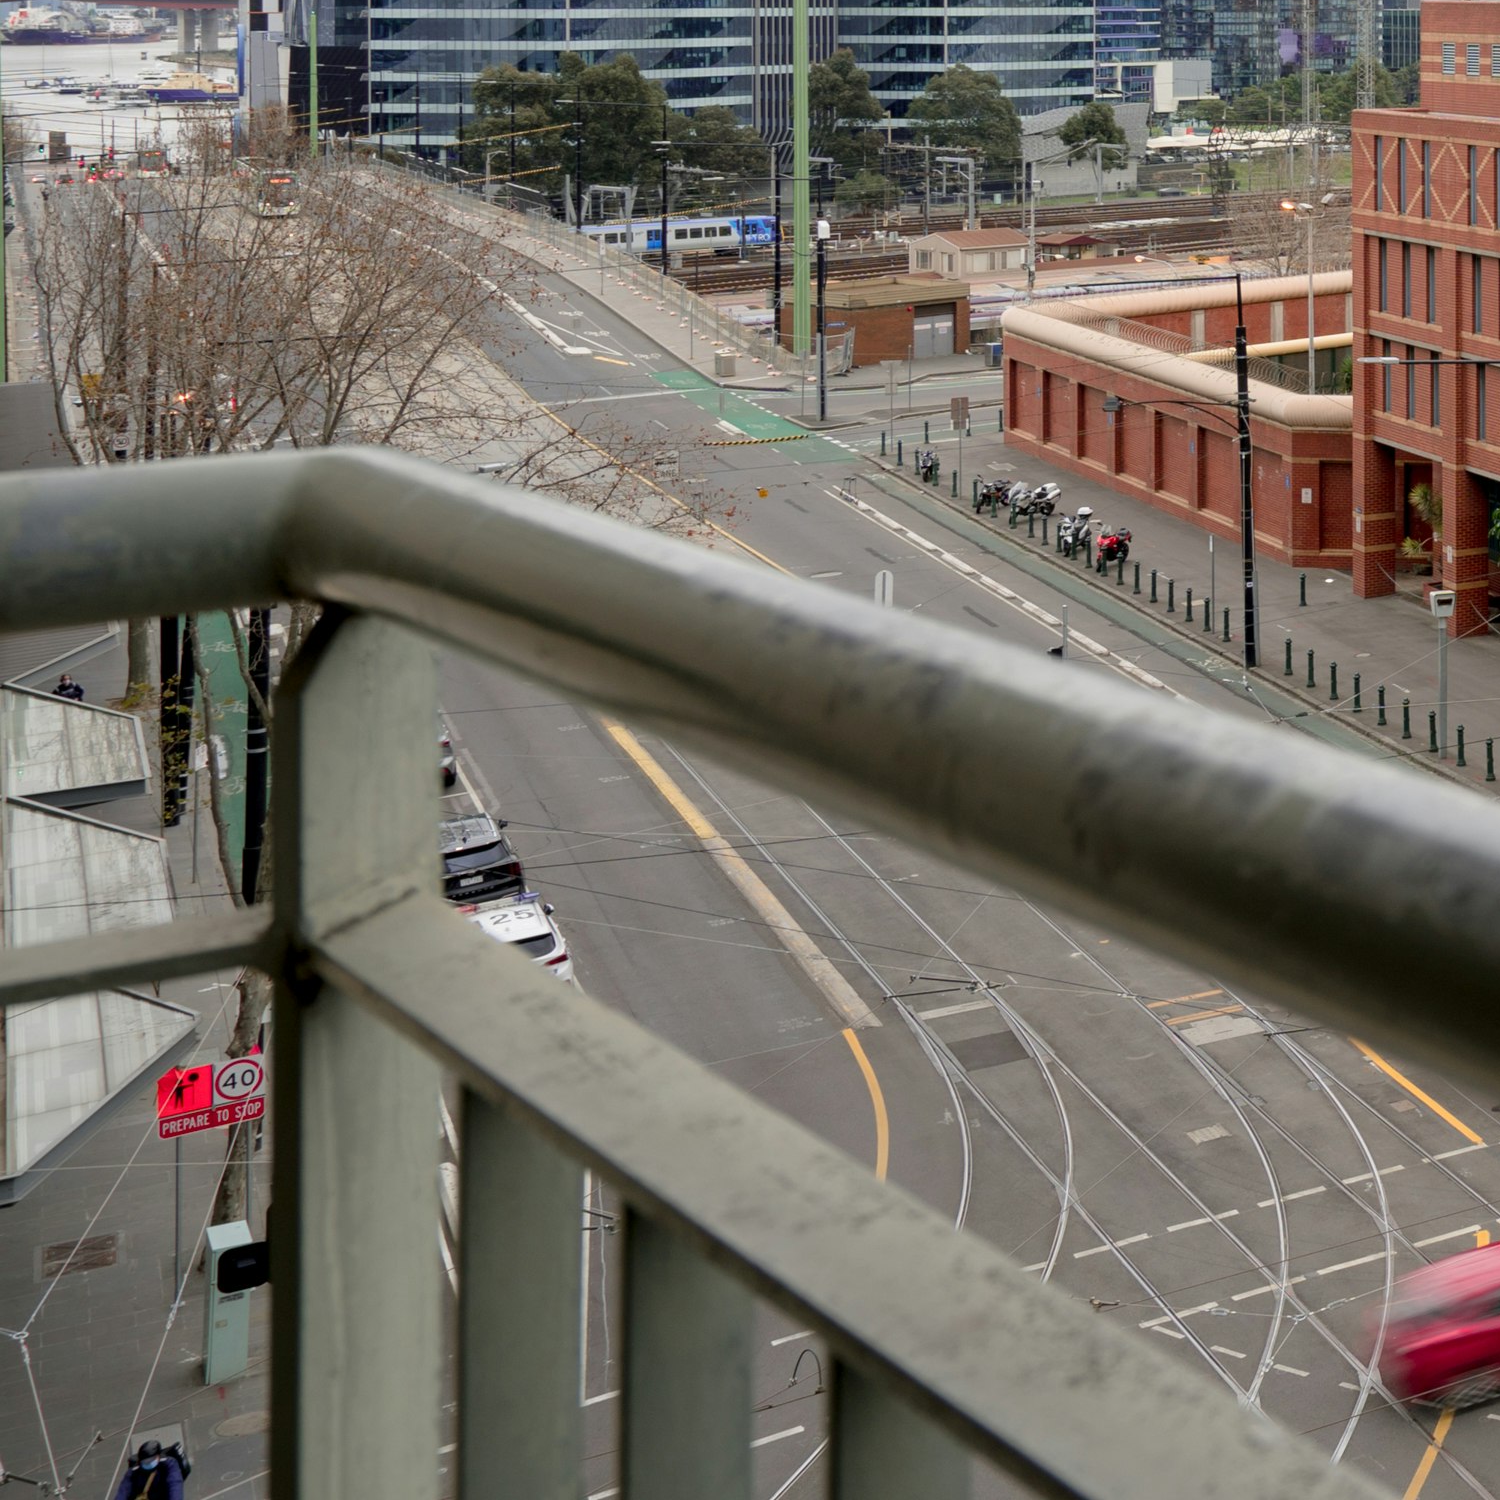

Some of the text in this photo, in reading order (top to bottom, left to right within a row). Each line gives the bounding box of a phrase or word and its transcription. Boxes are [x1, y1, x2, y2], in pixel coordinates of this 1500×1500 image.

[222, 1069, 255, 1089] 40
[162, 1101, 261, 1136] PREPARE TO STOP
